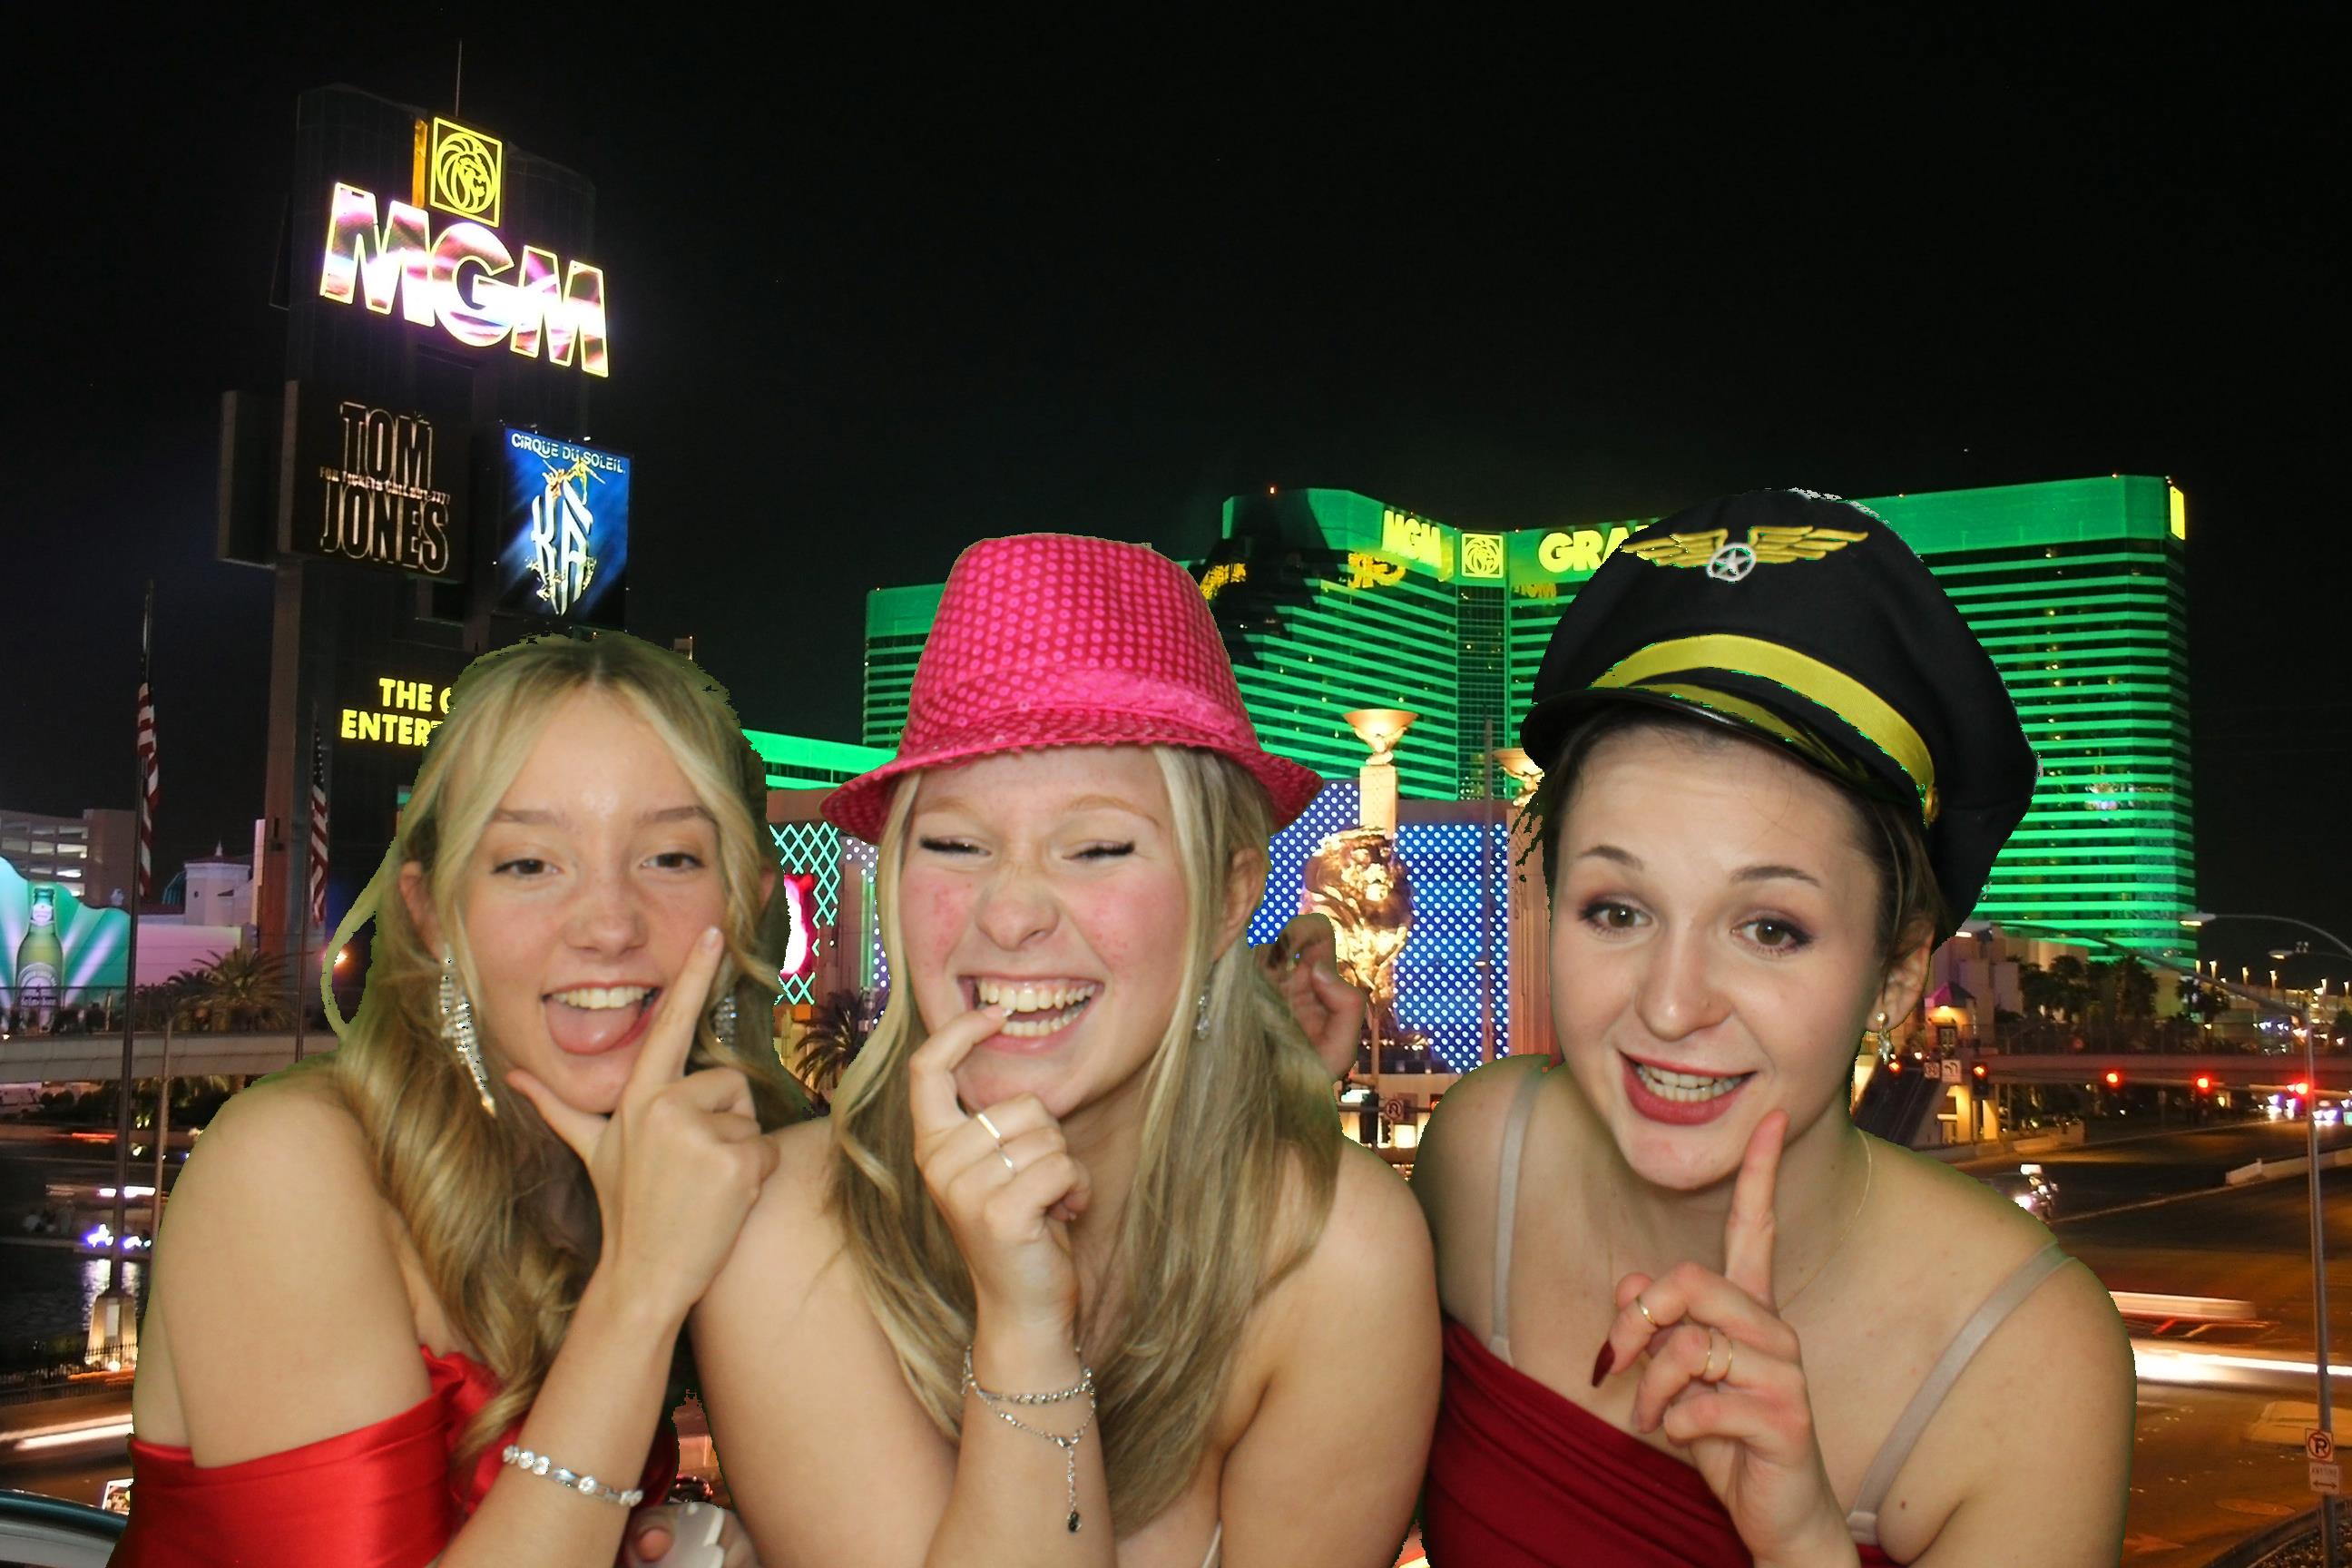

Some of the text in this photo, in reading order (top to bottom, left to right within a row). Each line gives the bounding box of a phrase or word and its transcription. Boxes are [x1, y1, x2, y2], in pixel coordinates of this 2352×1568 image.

[319, 181, 610, 378] MGM
[339, 401, 433, 488] TOM
[511, 433, 624, 473] CIRQUE DU SOLEIL
[319, 483, 449, 573] JONES
[1382, 510, 1649, 573] MGM GRA
[378, 677, 433, 712] THE
